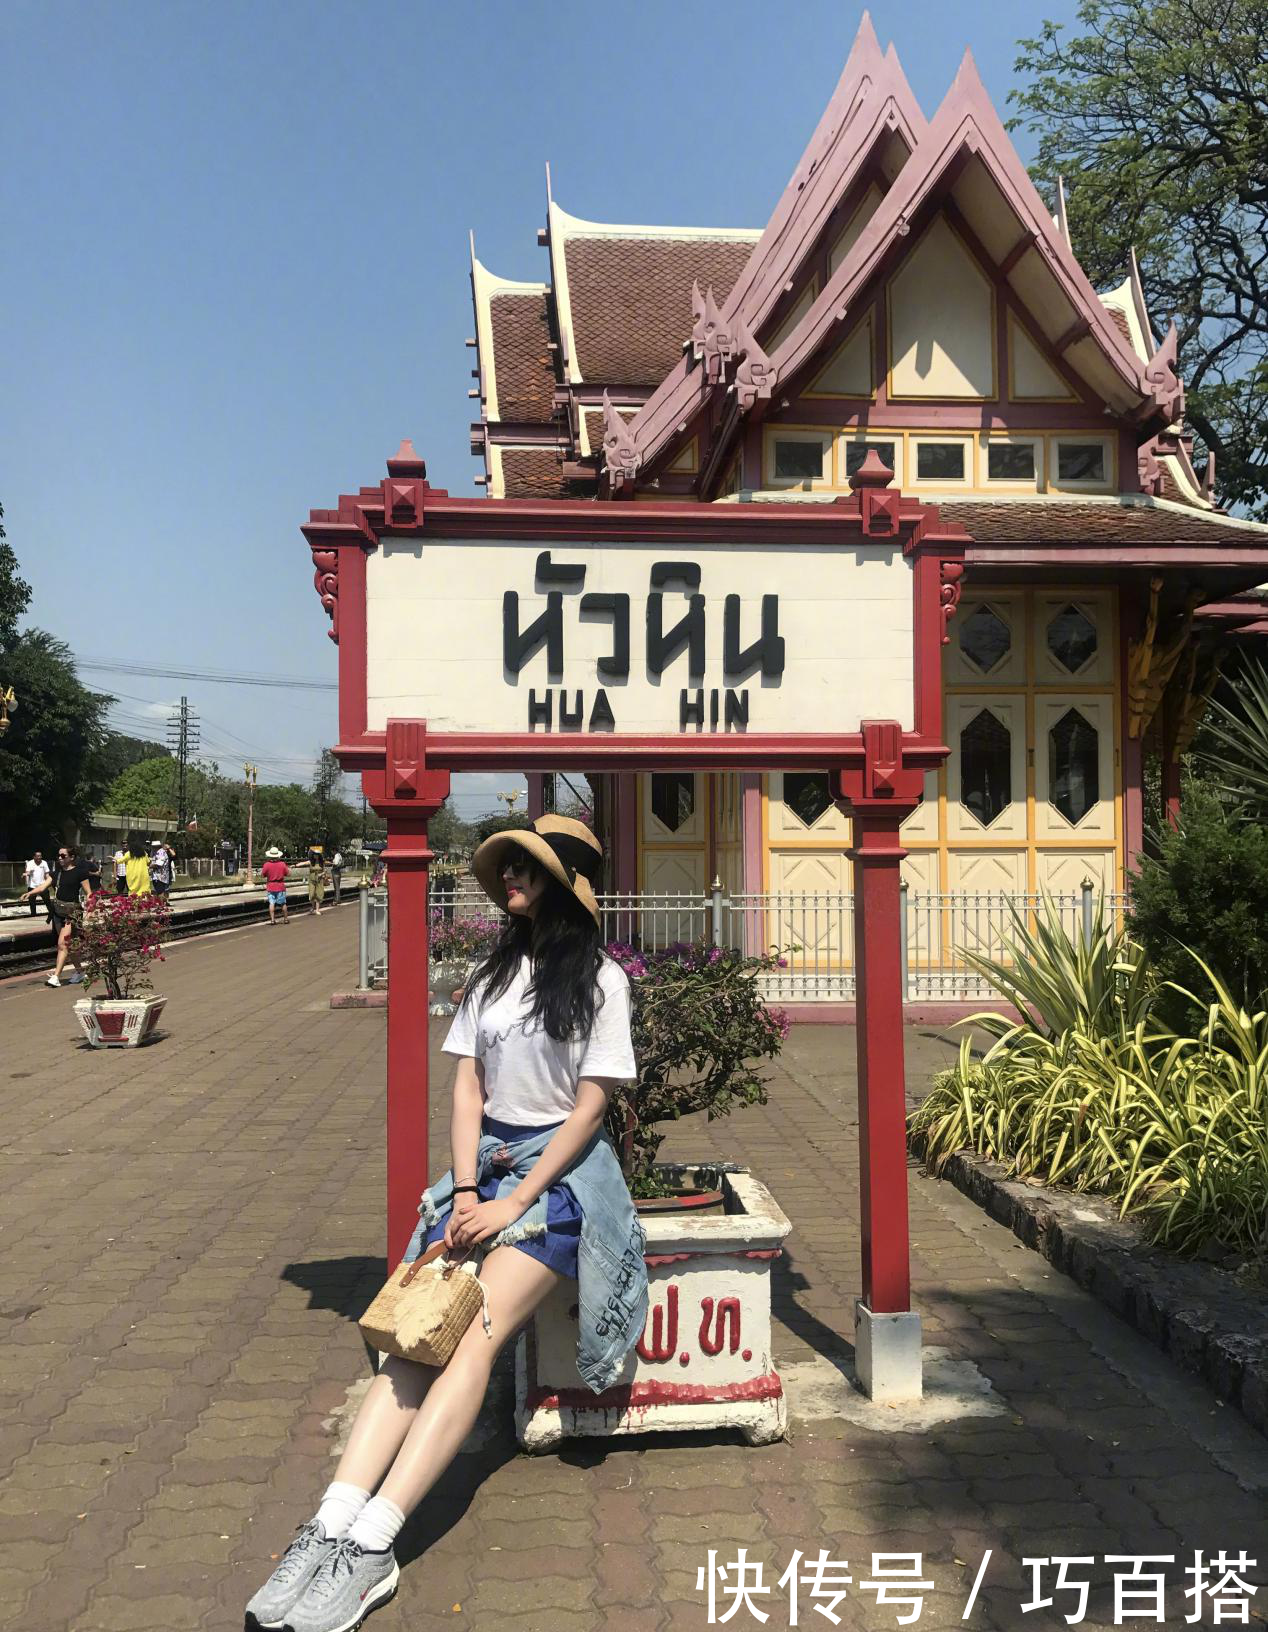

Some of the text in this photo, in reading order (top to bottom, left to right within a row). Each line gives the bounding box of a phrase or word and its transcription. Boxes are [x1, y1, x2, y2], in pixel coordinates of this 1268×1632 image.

[503, 551, 785, 675] หัวหิน
[528, 688, 750, 727] HUA HIN
